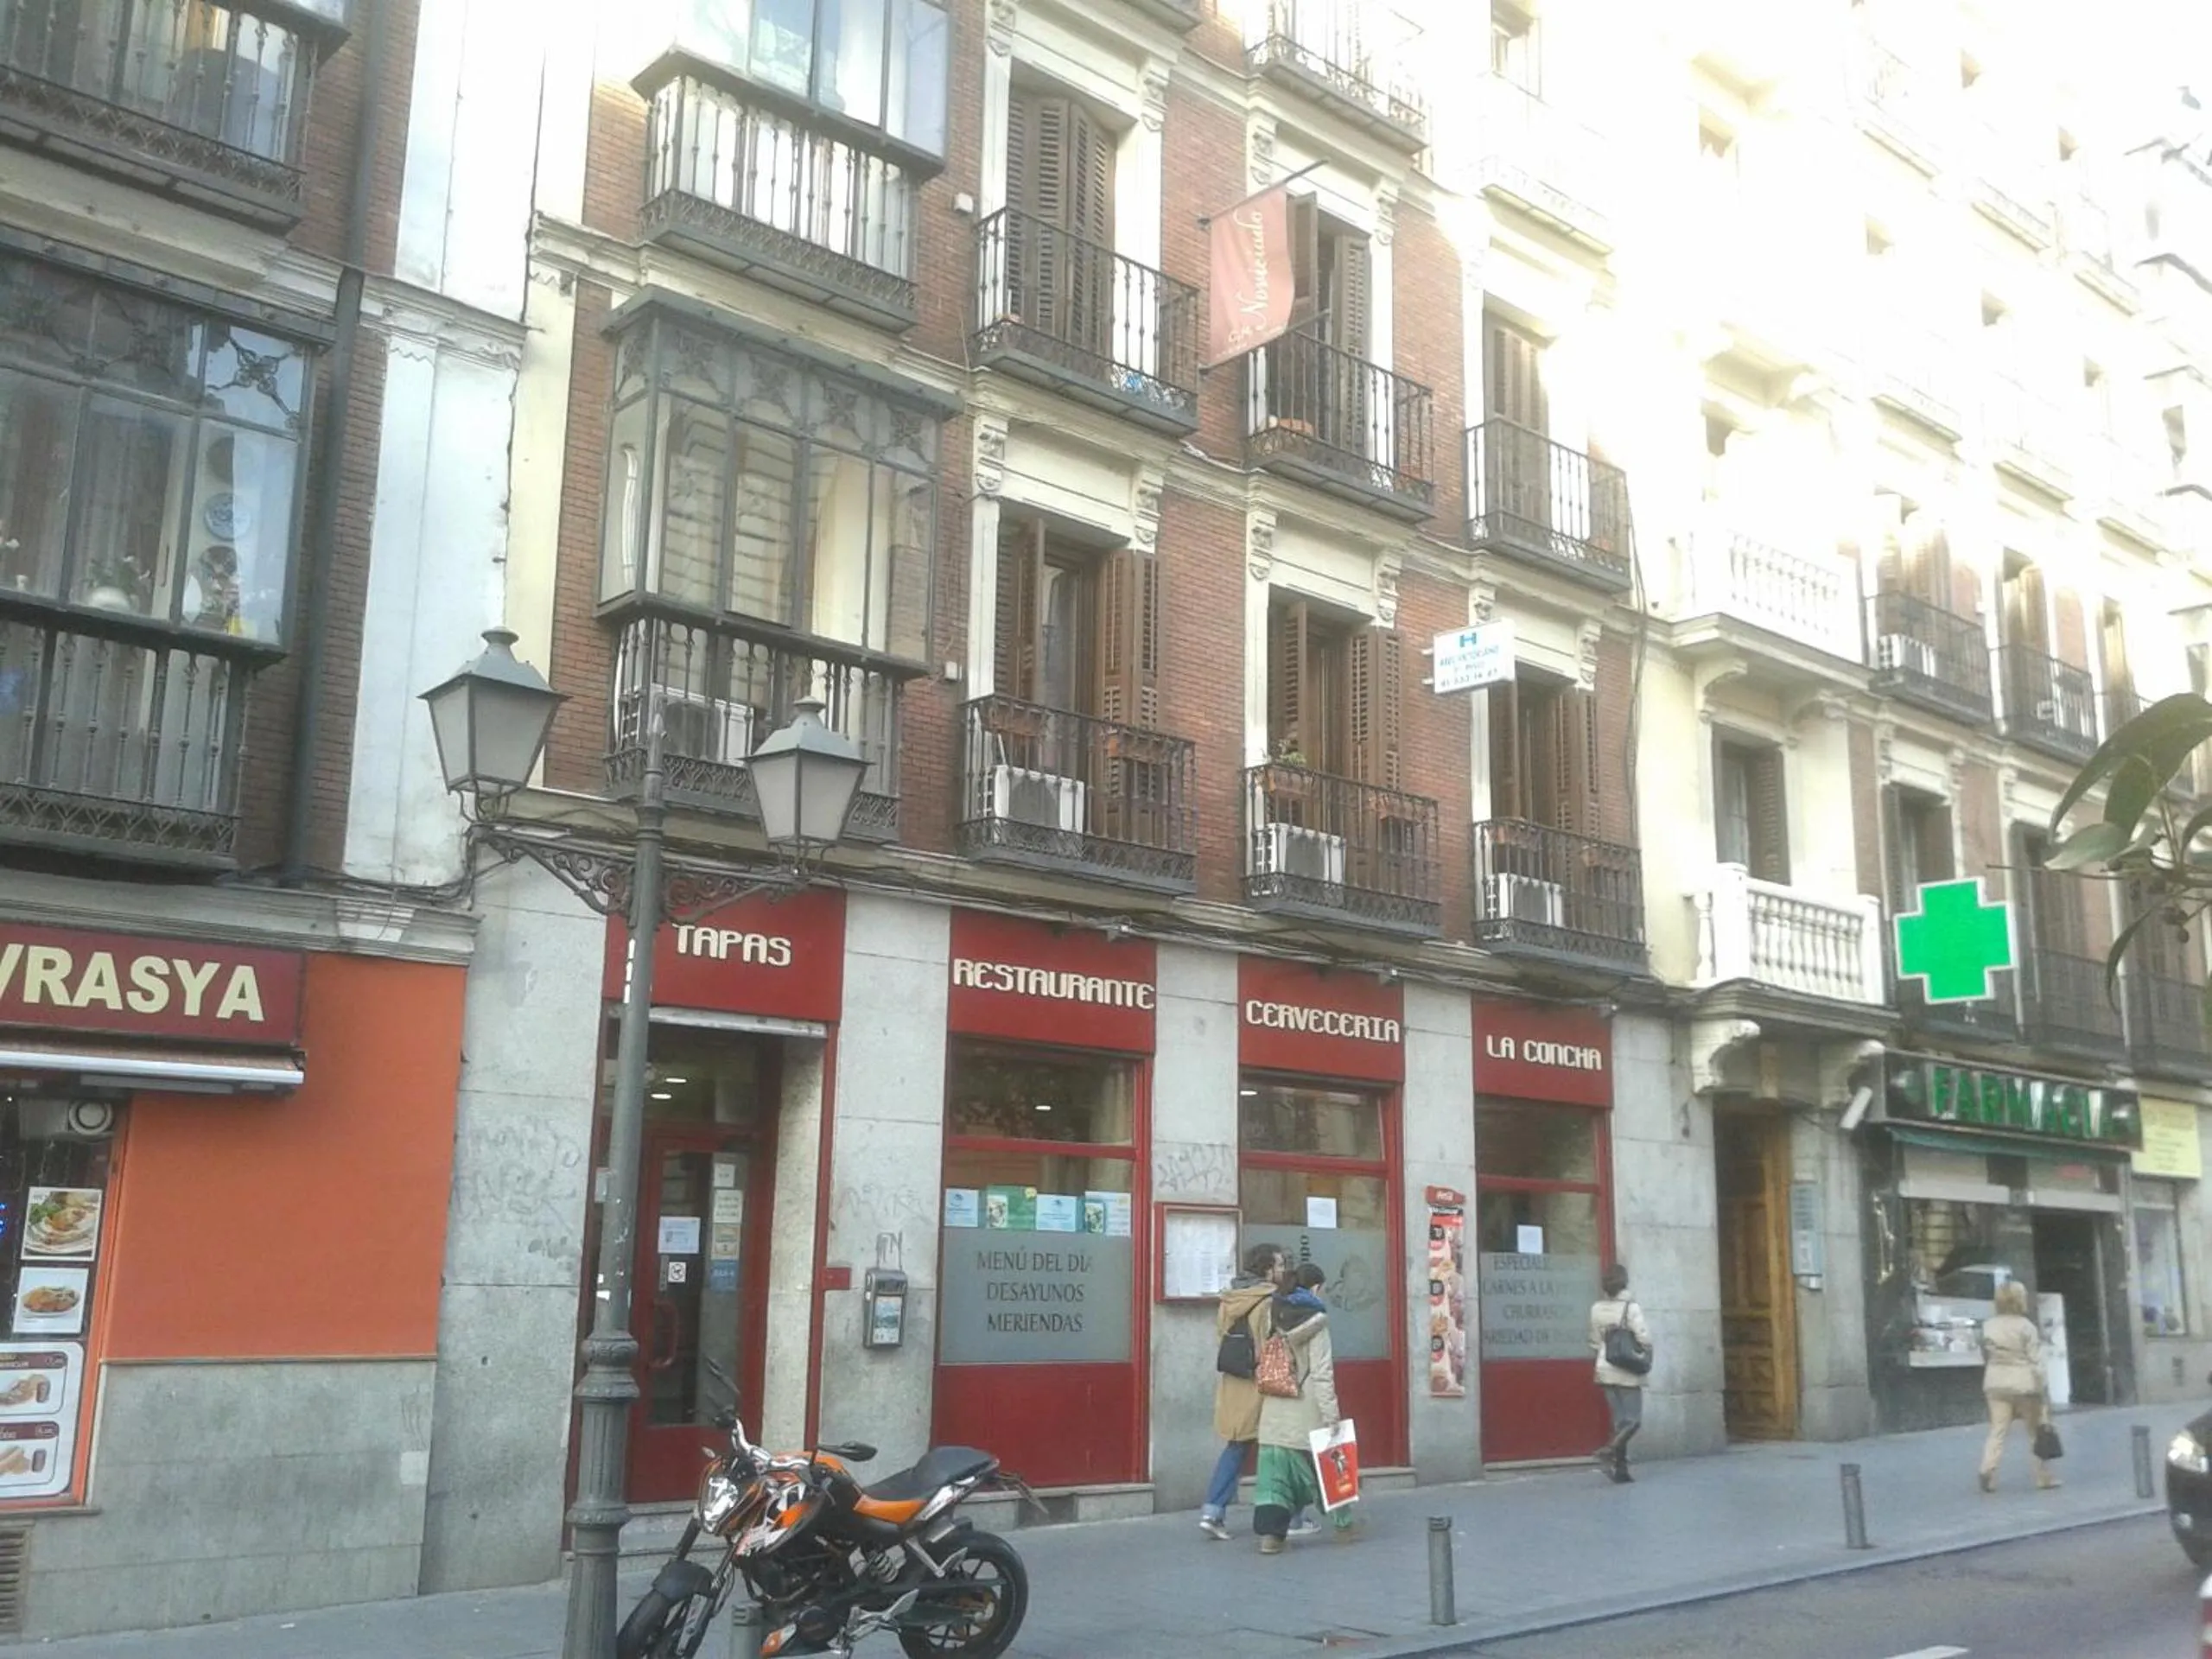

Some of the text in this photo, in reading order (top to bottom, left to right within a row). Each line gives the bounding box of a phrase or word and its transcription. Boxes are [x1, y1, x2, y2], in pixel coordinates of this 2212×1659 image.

[1459, 632, 1477, 648] H
[672, 923, 791, 967] TAPAS
[953, 957, 1155, 1010] RESTAURANTE
[1246, 1000, 1400, 1044] CERVECERIA
[1486, 1034, 1602, 1071] LA CONCHA
[1925, 1063, 2126, 1141] FARMACIA
[976, 1244, 1027, 1271] MENÚ
[1033, 1252, 1063, 1272] DEL
[986, 1281, 1085, 1303] DESAYUNOS
[986, 1313, 1084, 1333] MERIENDAS
